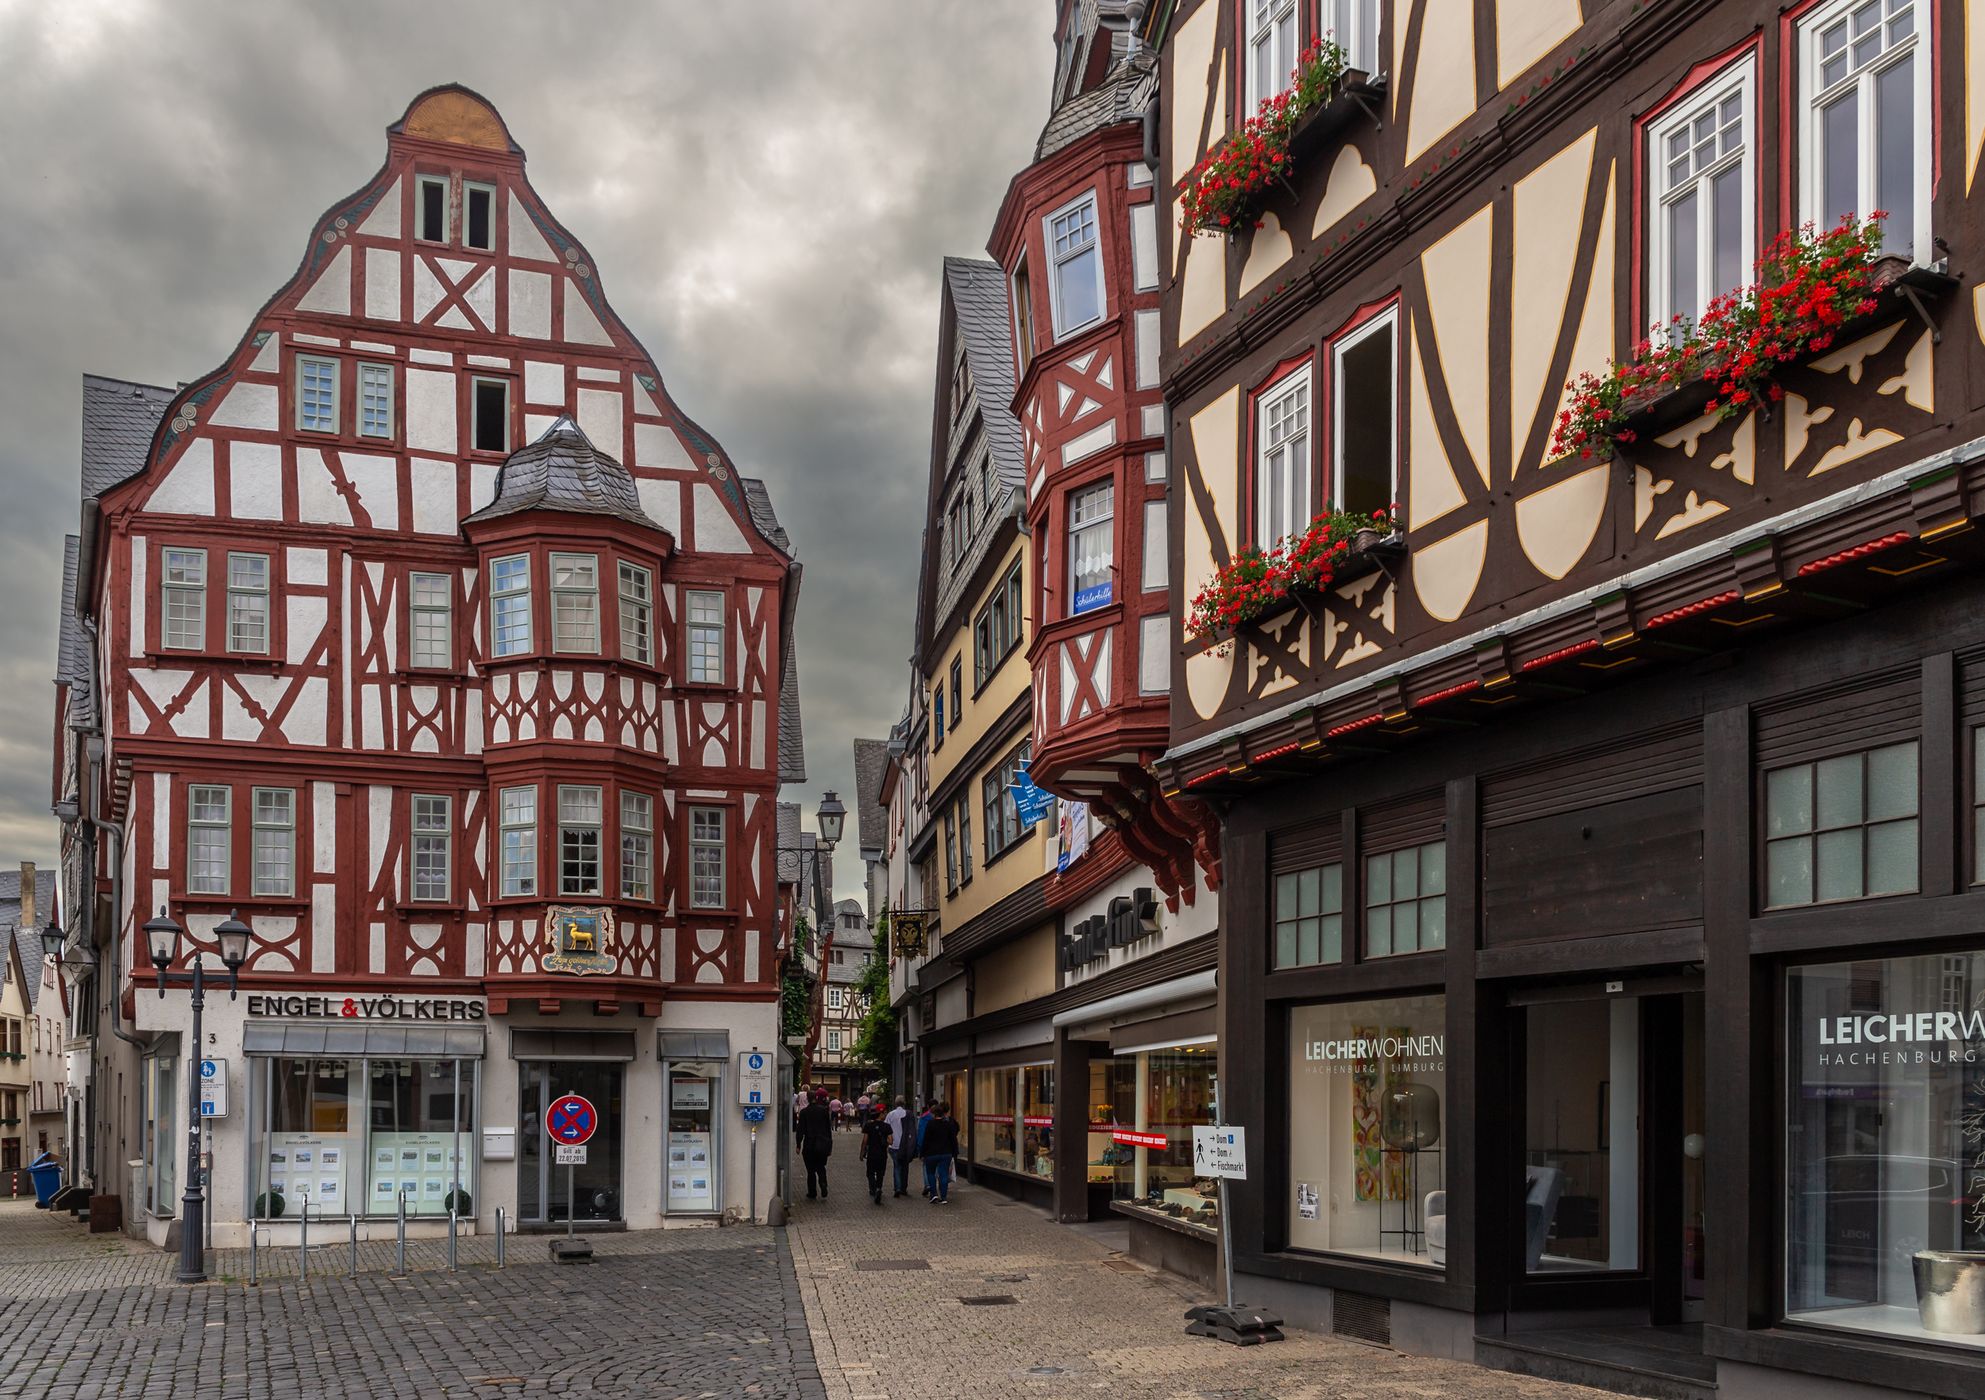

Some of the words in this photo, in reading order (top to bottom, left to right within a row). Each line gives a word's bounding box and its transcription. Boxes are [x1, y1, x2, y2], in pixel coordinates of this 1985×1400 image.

[209, 1033, 217, 1044] 3
[1305, 1035, 1444, 1061] LEICHERWOHNEN
[1819, 1050, 1976, 1065] HACHENBURG
[1305, 1064, 1375, 1074] HACHENBURG
[1391, 1062, 1444, 1073] LIMBURG
[1216, 1134, 1227, 1144] Dom
[1217, 1147, 1228, 1157] Dom
[1217, 1160, 1244, 1172] Fischmarkt
